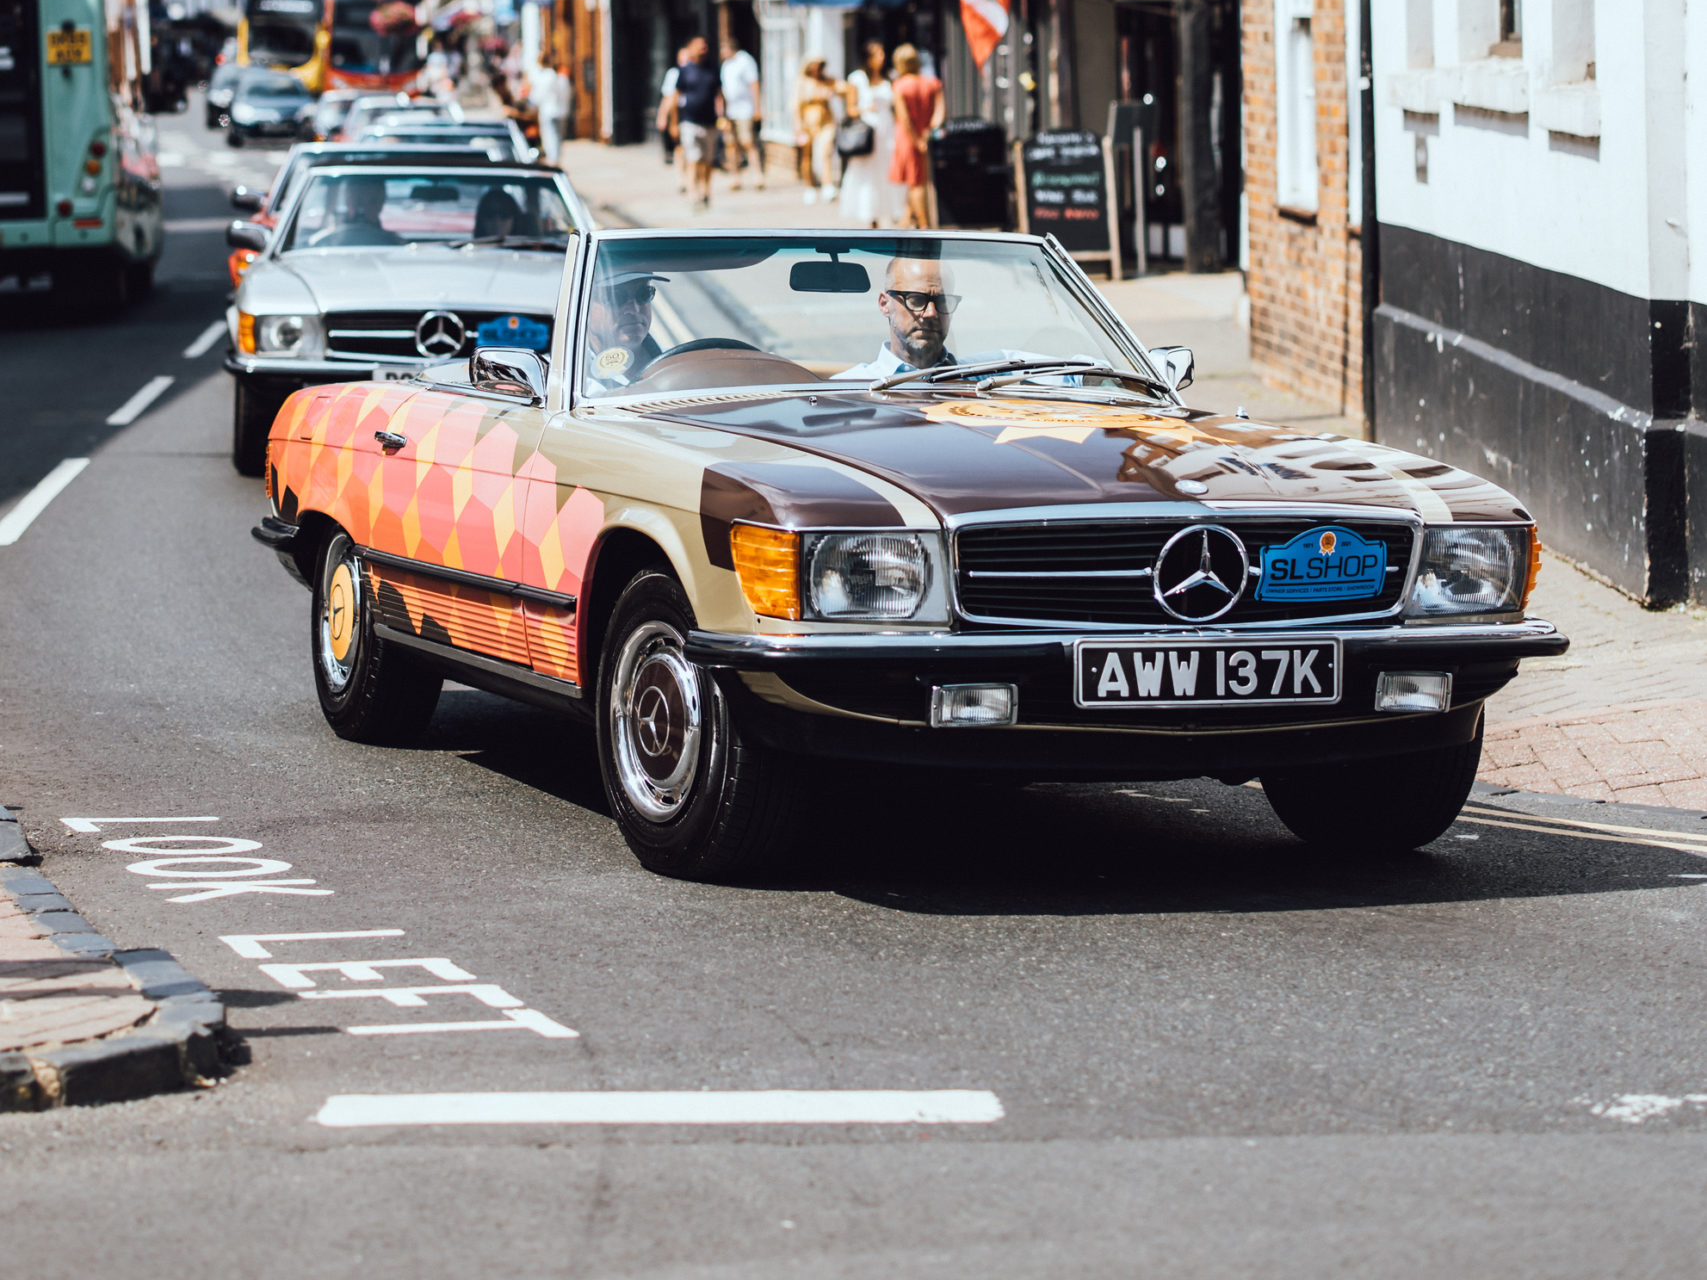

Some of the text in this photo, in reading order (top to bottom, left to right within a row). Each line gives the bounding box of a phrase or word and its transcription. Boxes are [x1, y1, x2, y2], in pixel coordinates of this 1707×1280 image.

[1097, 649, 1322, 698] AWW 137K
[60, 816, 581, 1039] LOOK LEFT
